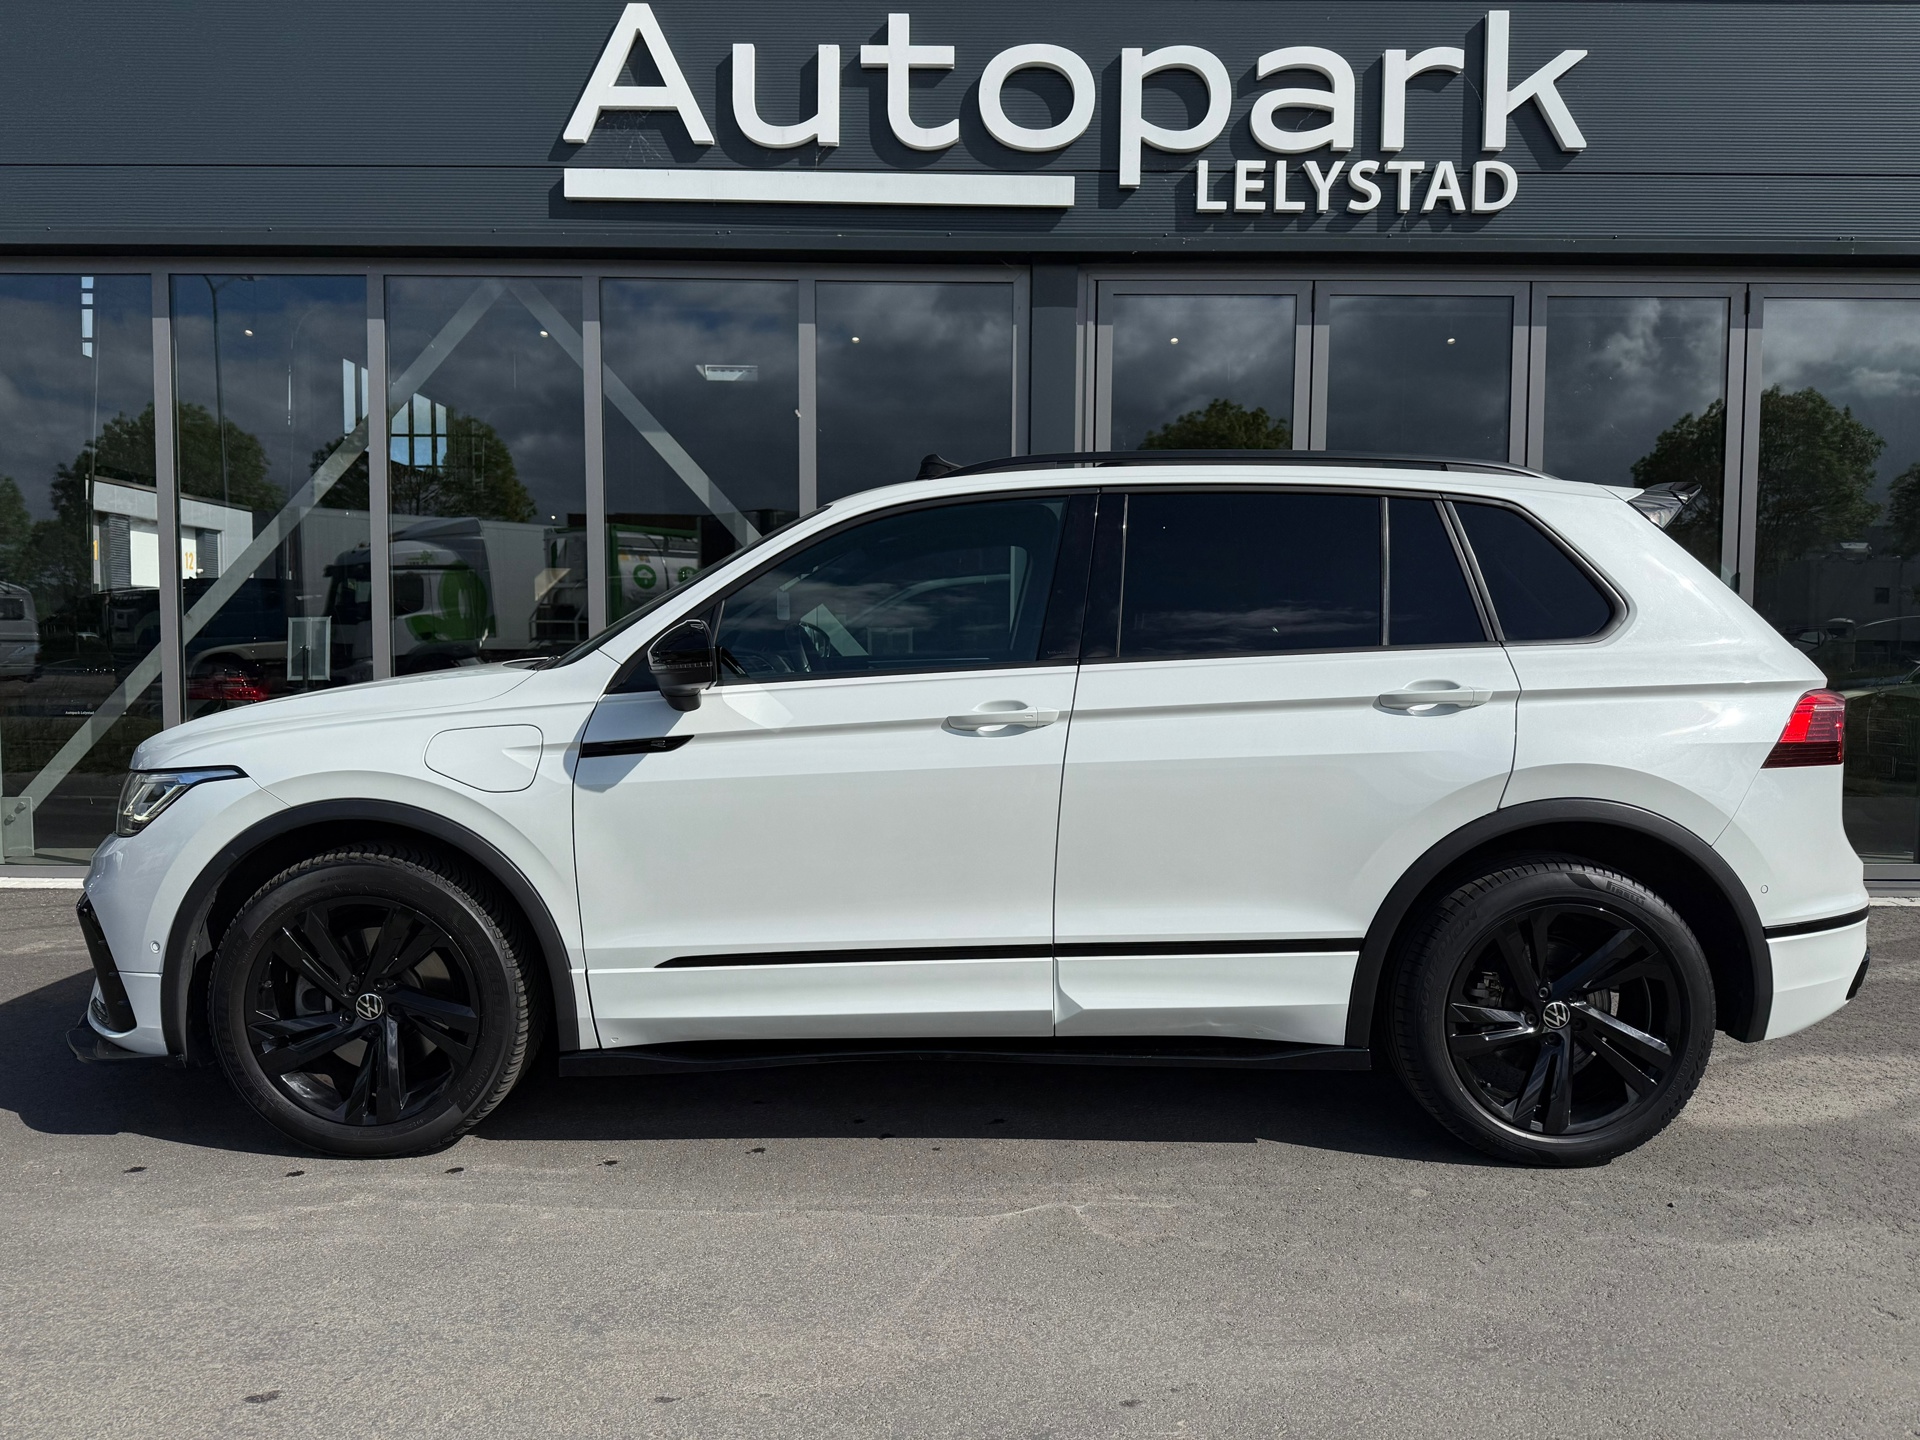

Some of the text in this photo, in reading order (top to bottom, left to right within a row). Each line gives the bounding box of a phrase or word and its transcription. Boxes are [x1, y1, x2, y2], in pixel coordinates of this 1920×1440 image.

[563, 2, 1589, 189] Autopark
[1195, 160, 1519, 214] LELYSTAD
[185, 552, 194, 570] 12
[1605, 880, 1646, 906] PIRELLI
[1418, 906, 1481, 1023] SCORPION
